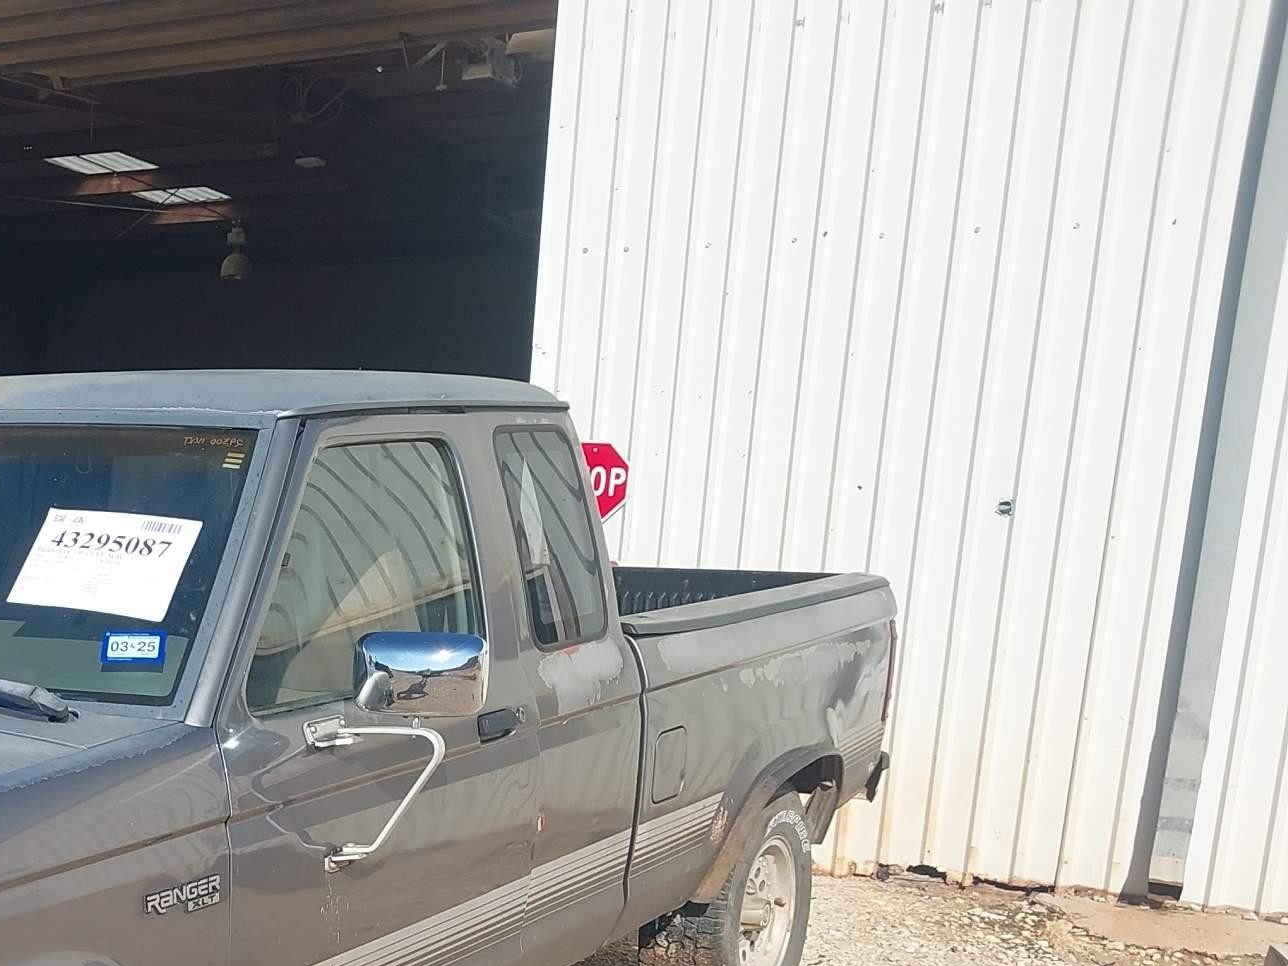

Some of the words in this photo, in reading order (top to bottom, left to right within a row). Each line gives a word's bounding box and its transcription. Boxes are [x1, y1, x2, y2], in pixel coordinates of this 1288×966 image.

[591, 466, 627, 497] OP
[51, 531, 173, 558] 43295087
[110, 641, 129, 652] 03
[136, 641, 157, 652] 25
[146, 874, 221, 914] RANGER
[190, 894, 219, 911] XLT
